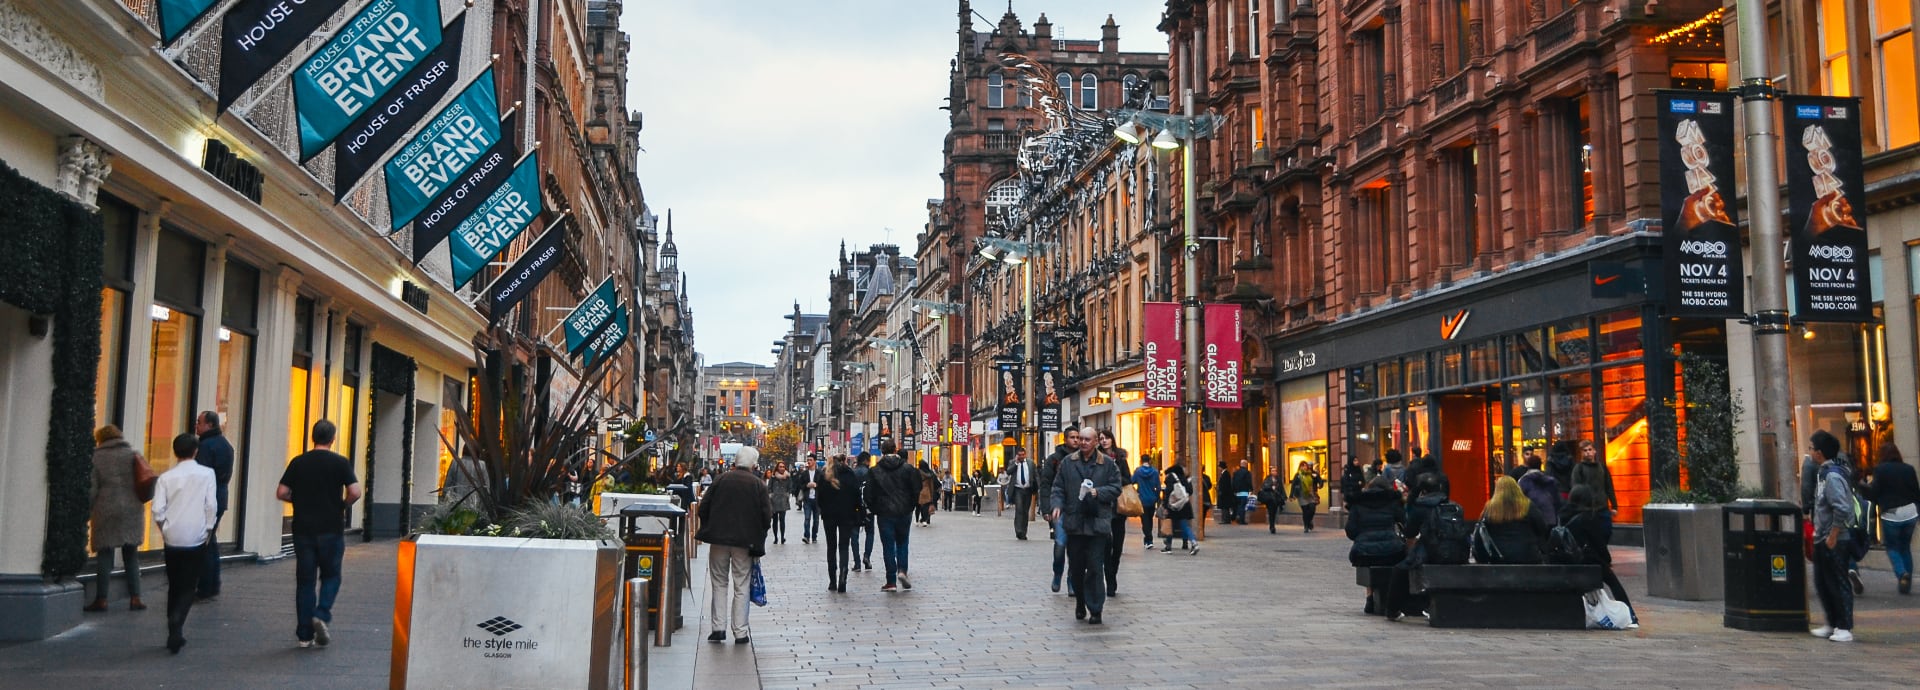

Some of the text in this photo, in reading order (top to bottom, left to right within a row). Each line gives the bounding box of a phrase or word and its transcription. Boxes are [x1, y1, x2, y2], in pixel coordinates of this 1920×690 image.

[238, 1, 293, 51] HOUSE
[305, 0, 393, 76] HOUSE OF FRASER
[317, 12, 409, 96] BRAND
[334, 27, 427, 117] EVENT
[347, 60, 450, 154] HOUSE OF FRASER
[395, 103, 463, 167] HOUSE OF FRASER
[403, 115, 475, 184] BRAND
[417, 127, 489, 198] EVENT
[423, 152, 503, 229] HOUSE OF FRASER
[456, 182, 512, 235] HOUSE OF FRASER
[463, 191, 522, 247] BRAND
[475, 201, 533, 260] EVENT
[1680, 240, 1726, 254] MOBO
[1680, 264, 1727, 277] NOV 4
[1809, 244, 1853, 258] MOBO
[496, 246, 557, 302] HOUSE OF FRASER
[1809, 267, 1855, 281] NOV 4
[572, 298, 605, 331] BRAND
[578, 304, 611, 338] EVENT
[1681, 298, 1727, 306] MOBO.COM
[1811, 302, 1857, 310] MOBO.COM
[1147, 342, 1157, 400] GLASGOW
[1157, 368, 1166, 400] MAKE
[1167, 359, 1176, 401] PEOPLE
[1207, 343, 1218, 401] GLASGOW
[1218, 369, 1227, 402] MAKE
[1227, 361, 1237, 402] PEOPLE
[1452, 439, 1472, 451] NIKE
[463, 636, 539, 651] the style mile
